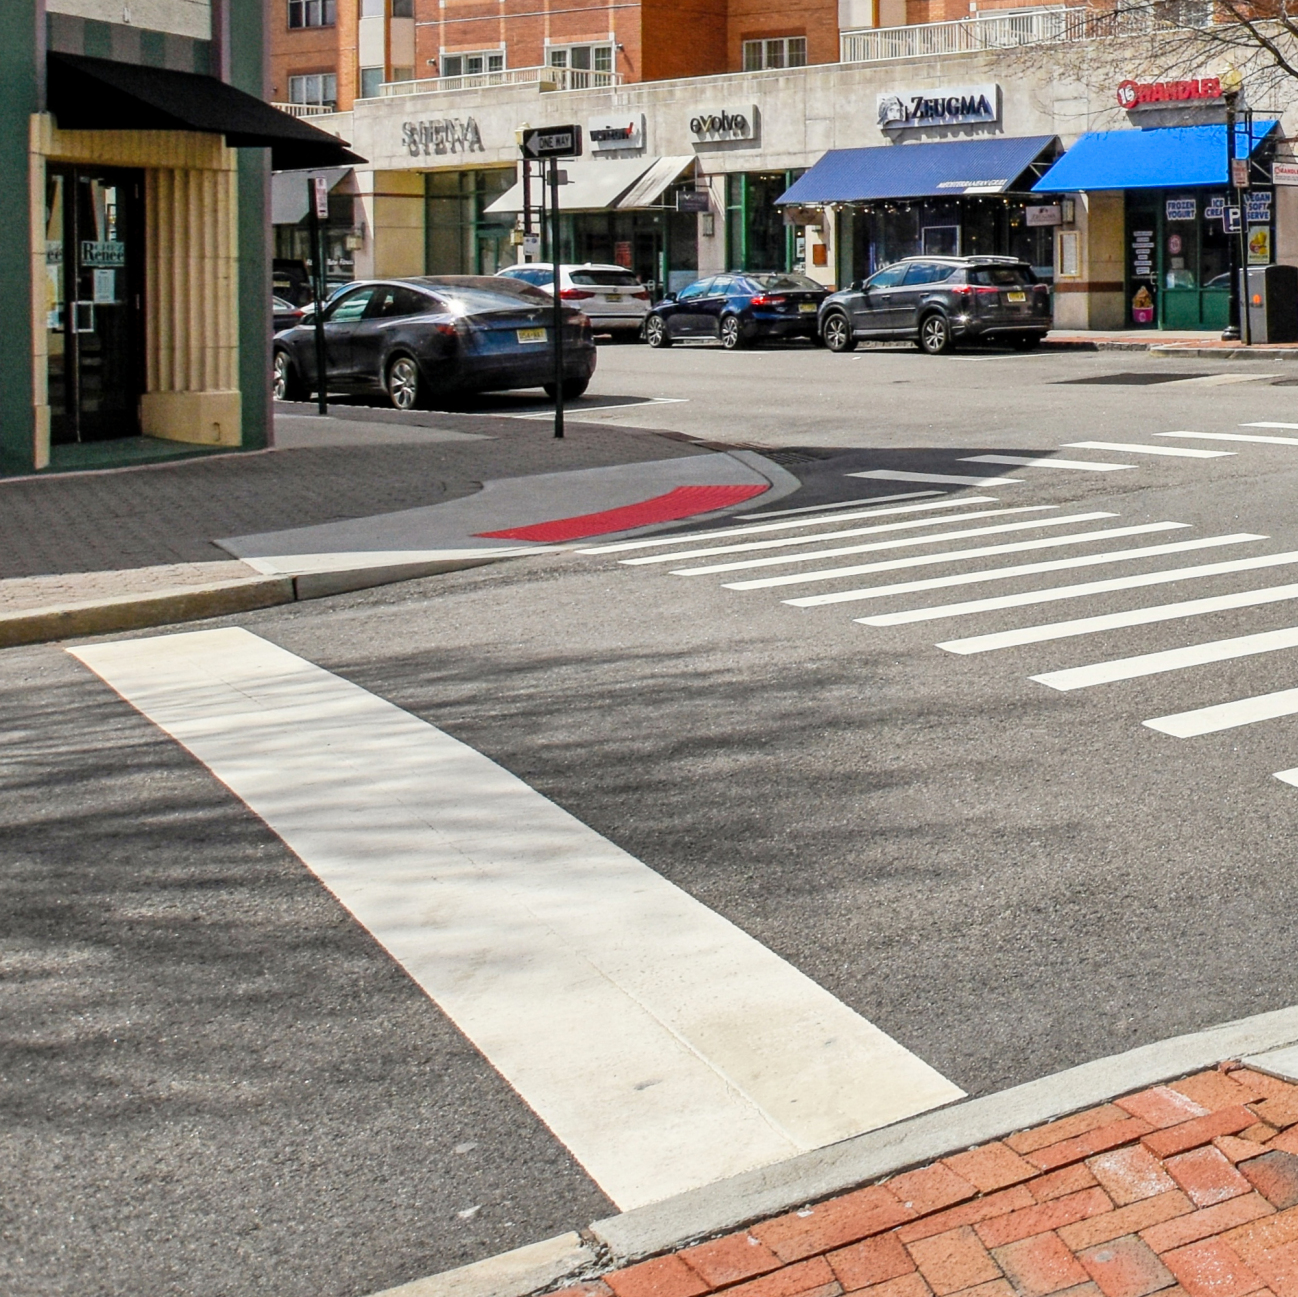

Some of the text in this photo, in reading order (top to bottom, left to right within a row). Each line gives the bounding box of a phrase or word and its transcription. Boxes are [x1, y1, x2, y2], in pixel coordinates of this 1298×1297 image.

[1118, 84, 1136, 105] 16
[911, 93, 992, 119] ZEUGMA
[689, 109, 746, 134] evolve
[402, 116, 482, 150] SIENA
[539, 135, 571, 150] ONE WAY
[1167, 201, 1195, 210] FROZEN
[1212, 199, 1224, 208] ICE
[1248, 203, 1268, 211] SOFT
[1168, 209, 1195, 219] YOGURT
[1229, 209, 1241, 224] P
[1246, 211, 1269, 220] SERVE
